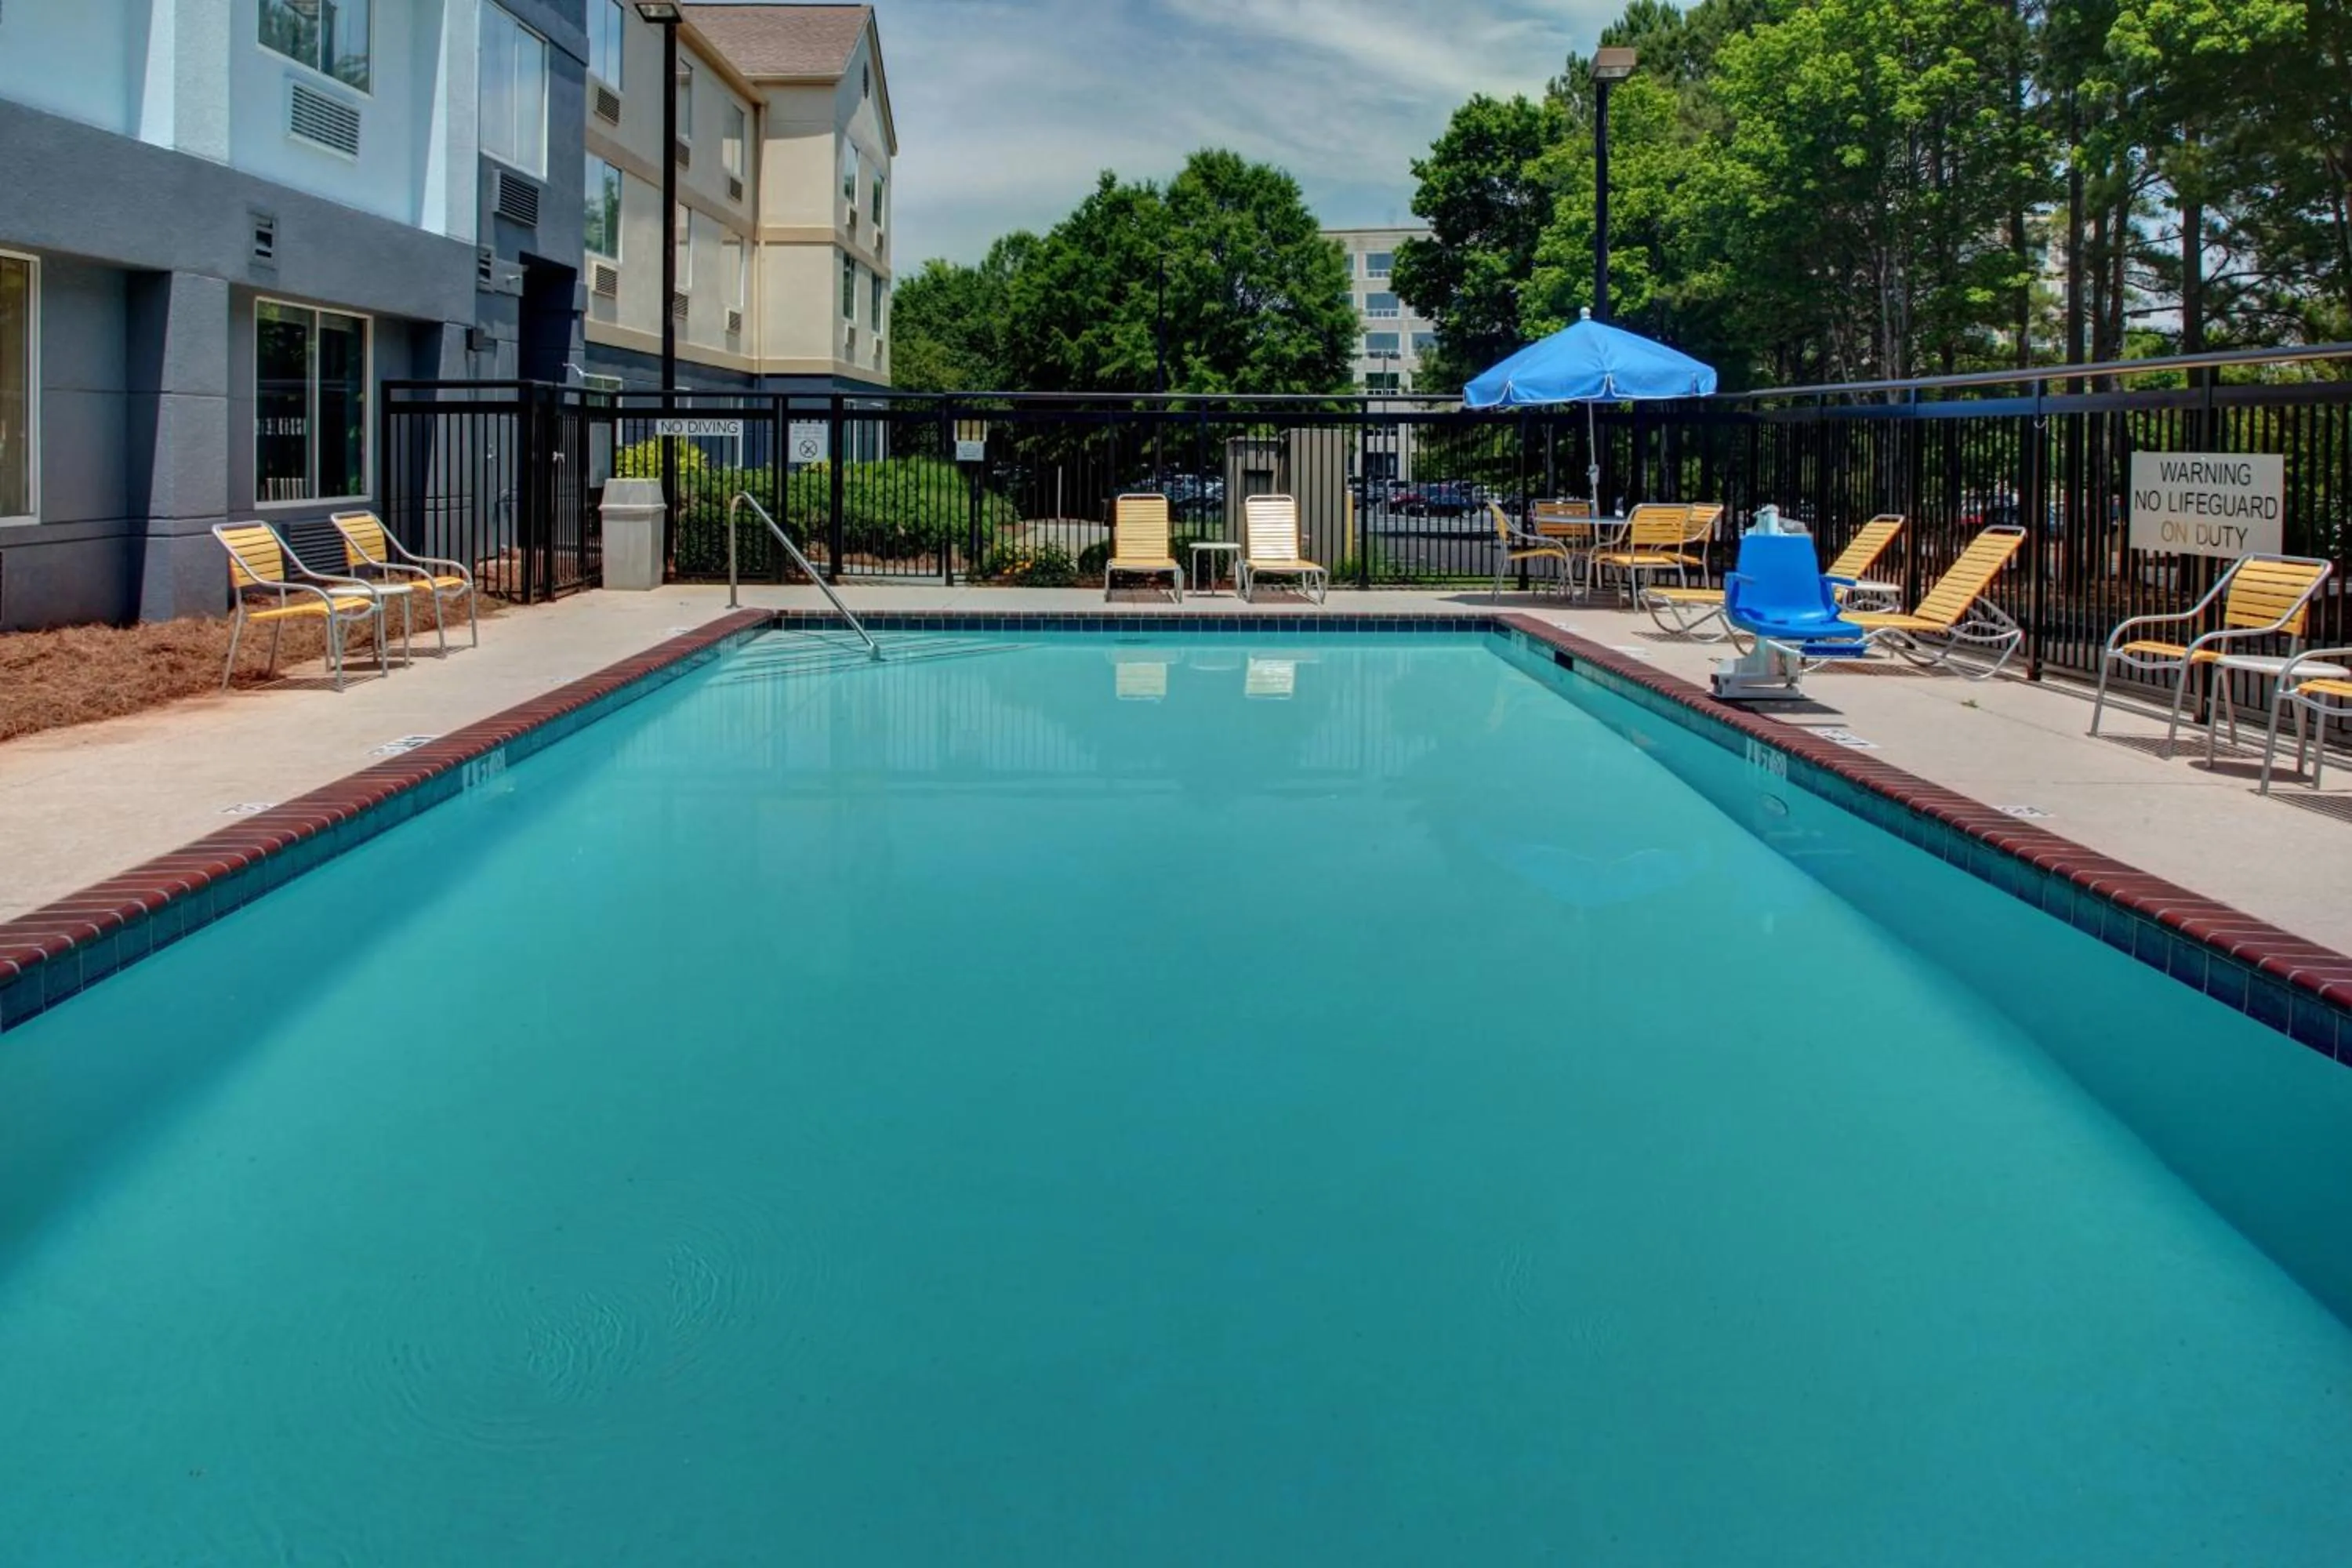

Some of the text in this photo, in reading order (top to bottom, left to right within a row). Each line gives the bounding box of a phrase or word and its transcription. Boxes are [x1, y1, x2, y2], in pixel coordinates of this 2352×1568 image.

[661, 420, 739, 434] NO DIVING
[2160, 462, 2251, 485] WARNING
[2135, 490, 2278, 519] NO LIFEGUARD
[2161, 521, 2248, 550] ON DUTY
